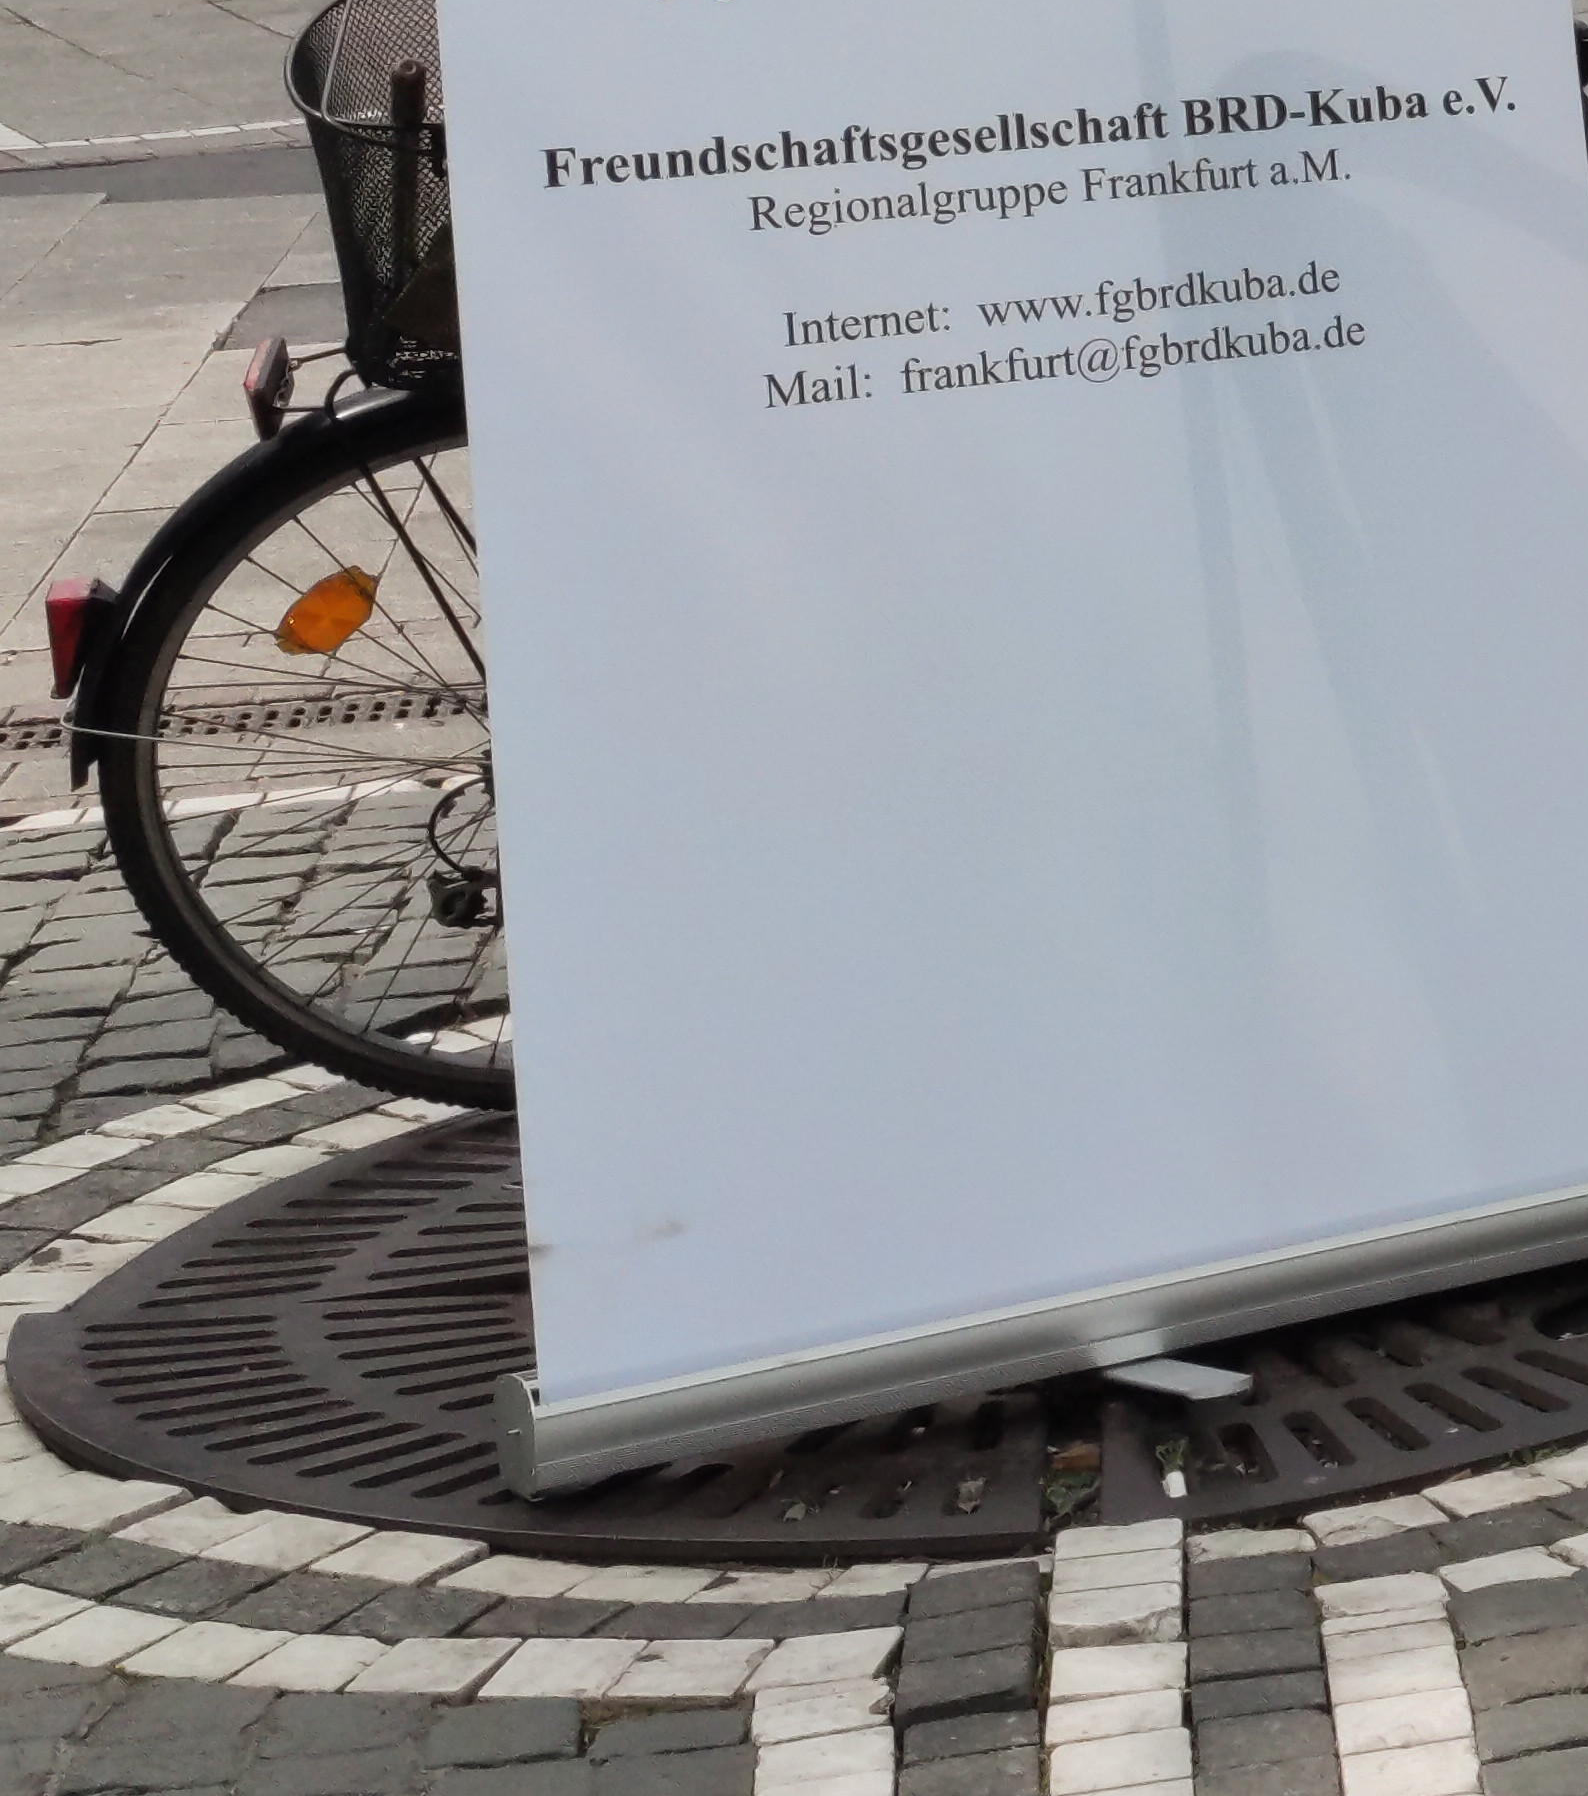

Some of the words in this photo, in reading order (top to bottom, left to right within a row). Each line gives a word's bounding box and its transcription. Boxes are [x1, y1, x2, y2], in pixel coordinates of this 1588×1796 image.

[541, 101, 1169, 189] Freundschaftsgesellschaft
[1181, 84, 1428, 141] BRD-Kuba
[1441, 75, 1517, 117] e.V.
[747, 173, 1069, 235] Regionalgruppe
[1081, 155, 1258, 205] Frankfurt
[1268, 148, 1352, 187] a.M.
[783, 300, 951, 347] Internet:
[976, 260, 1341, 328] www.fgbrdkuba.de
[763, 363, 873, 409] Mail:
[901, 315, 1366, 395] frankfurt@fgbrdkuba.de
